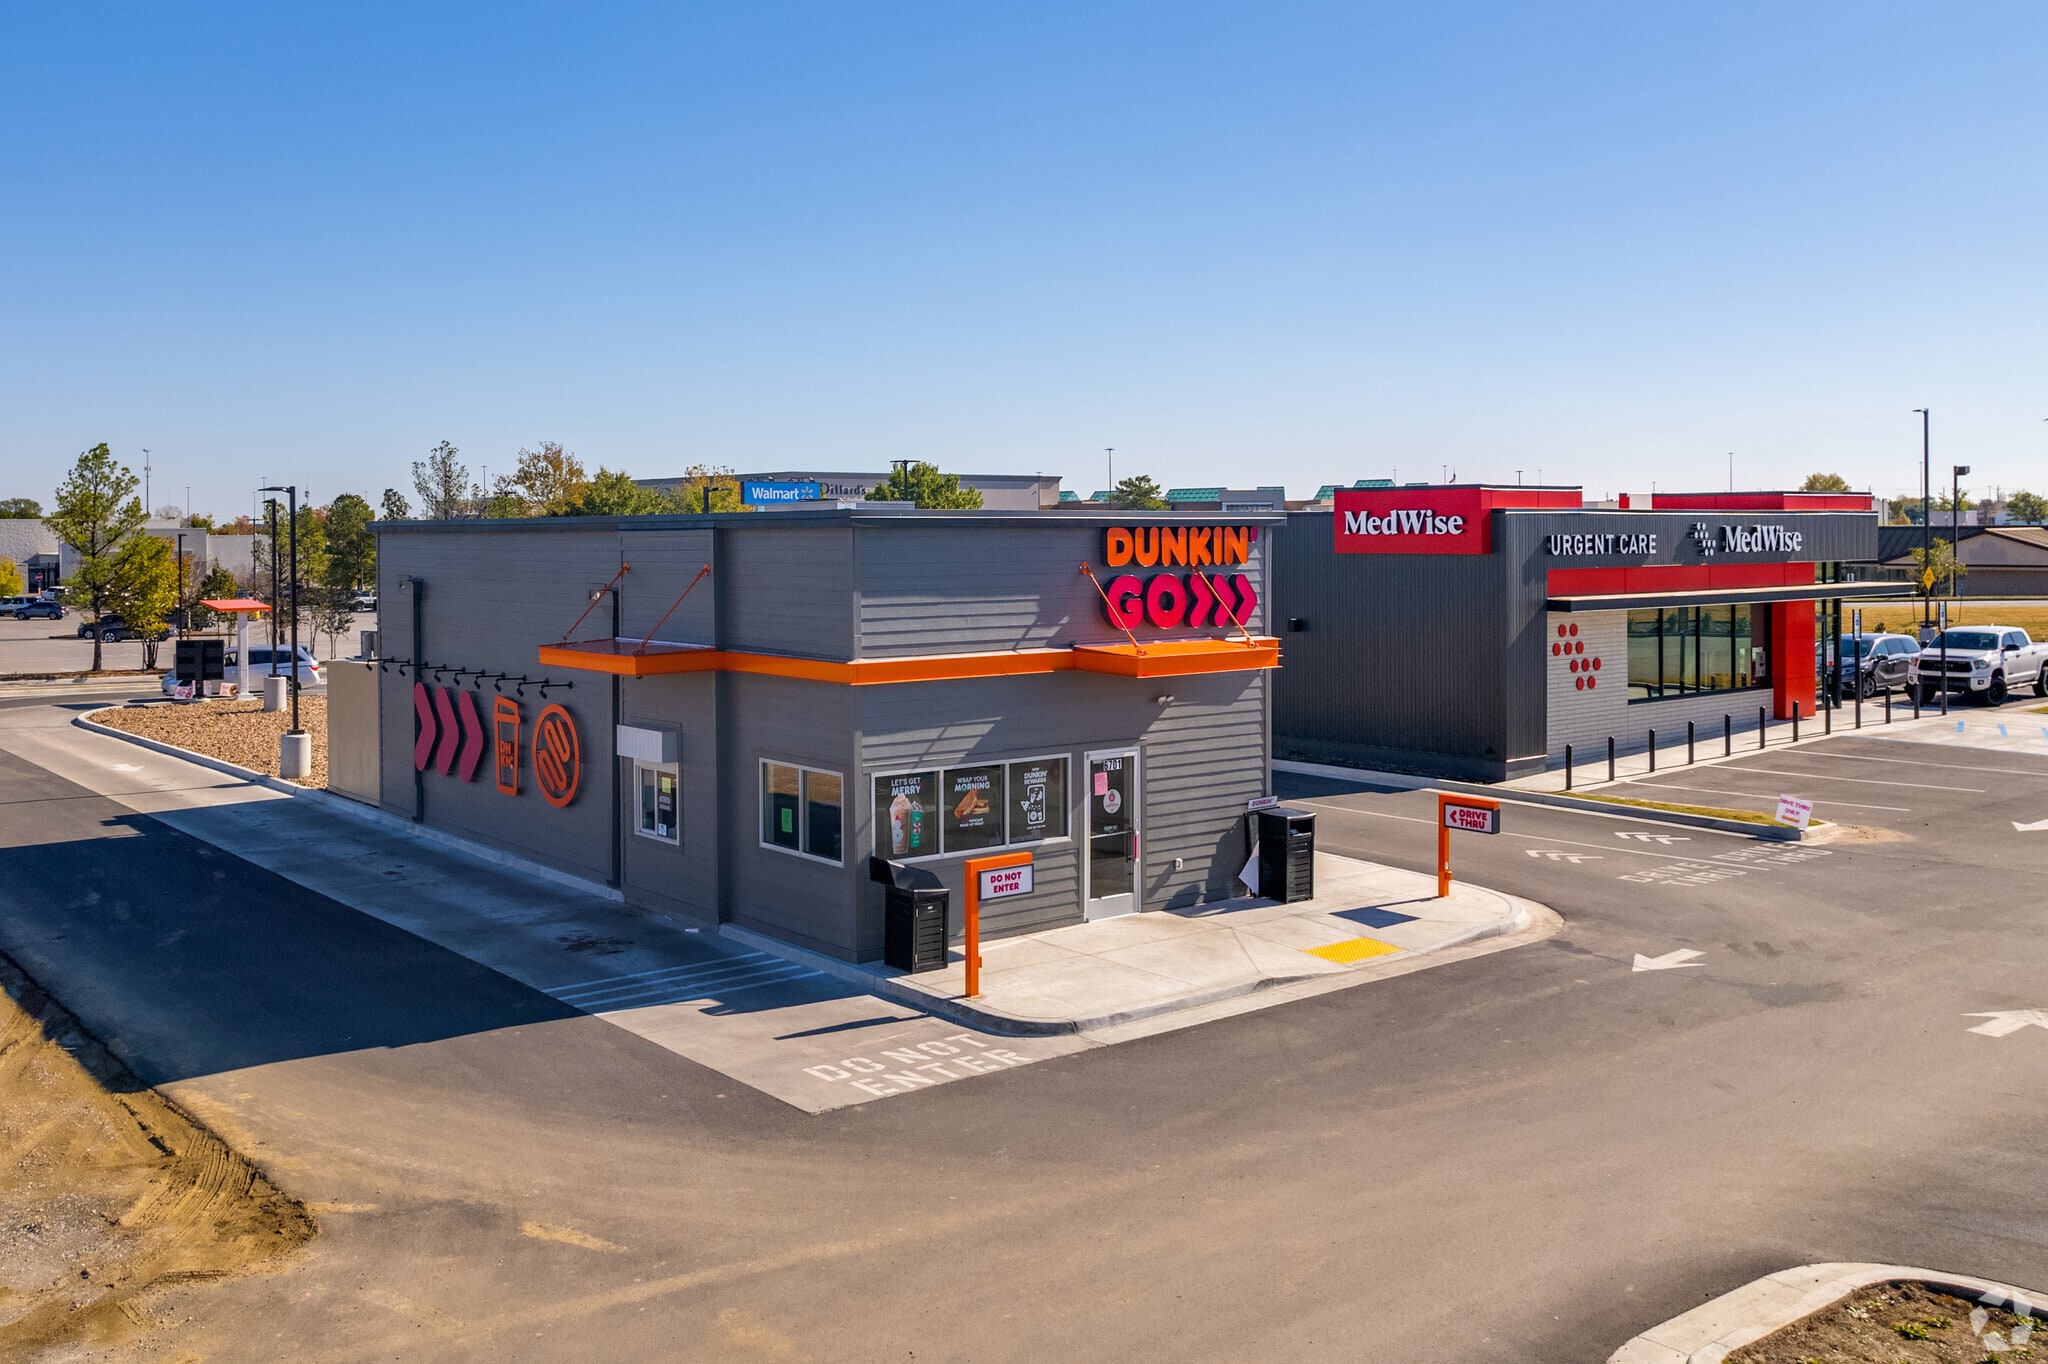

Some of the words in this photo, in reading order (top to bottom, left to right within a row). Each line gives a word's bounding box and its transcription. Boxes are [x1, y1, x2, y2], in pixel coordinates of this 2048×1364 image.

[752, 487, 799, 499] Walmart
[1344, 509, 1464, 535] MedWise
[1107, 526, 1259, 567] DUNKIN'
[1550, 534, 1614, 556] URGENT
[1619, 534, 1657, 554] CARE
[1725, 525, 1802, 552] MedWise
[891, 779, 907, 787] LET'S
[908, 777, 921, 785] GET
[891, 785, 921, 797] MERRY
[954, 782, 990, 792] MORNING
[1459, 809, 1487, 821] DRIVE
[1459, 818, 1485, 829] THRU
[1712, 842, 1797, 862] DRIVE
[1754, 848, 1833, 866] THRU
[990, 874, 1003, 883] DO
[1004, 871, 1022, 881] NOT
[1616, 862, 1711, 883] DRIVE
[1660, 868, 1747, 887] THRU
[993, 882, 1019, 893] ENTER
[802, 1057, 885, 1082] DO
[881, 1033, 988, 1064] NOT
[850, 1049, 1033, 1096] ENTER
